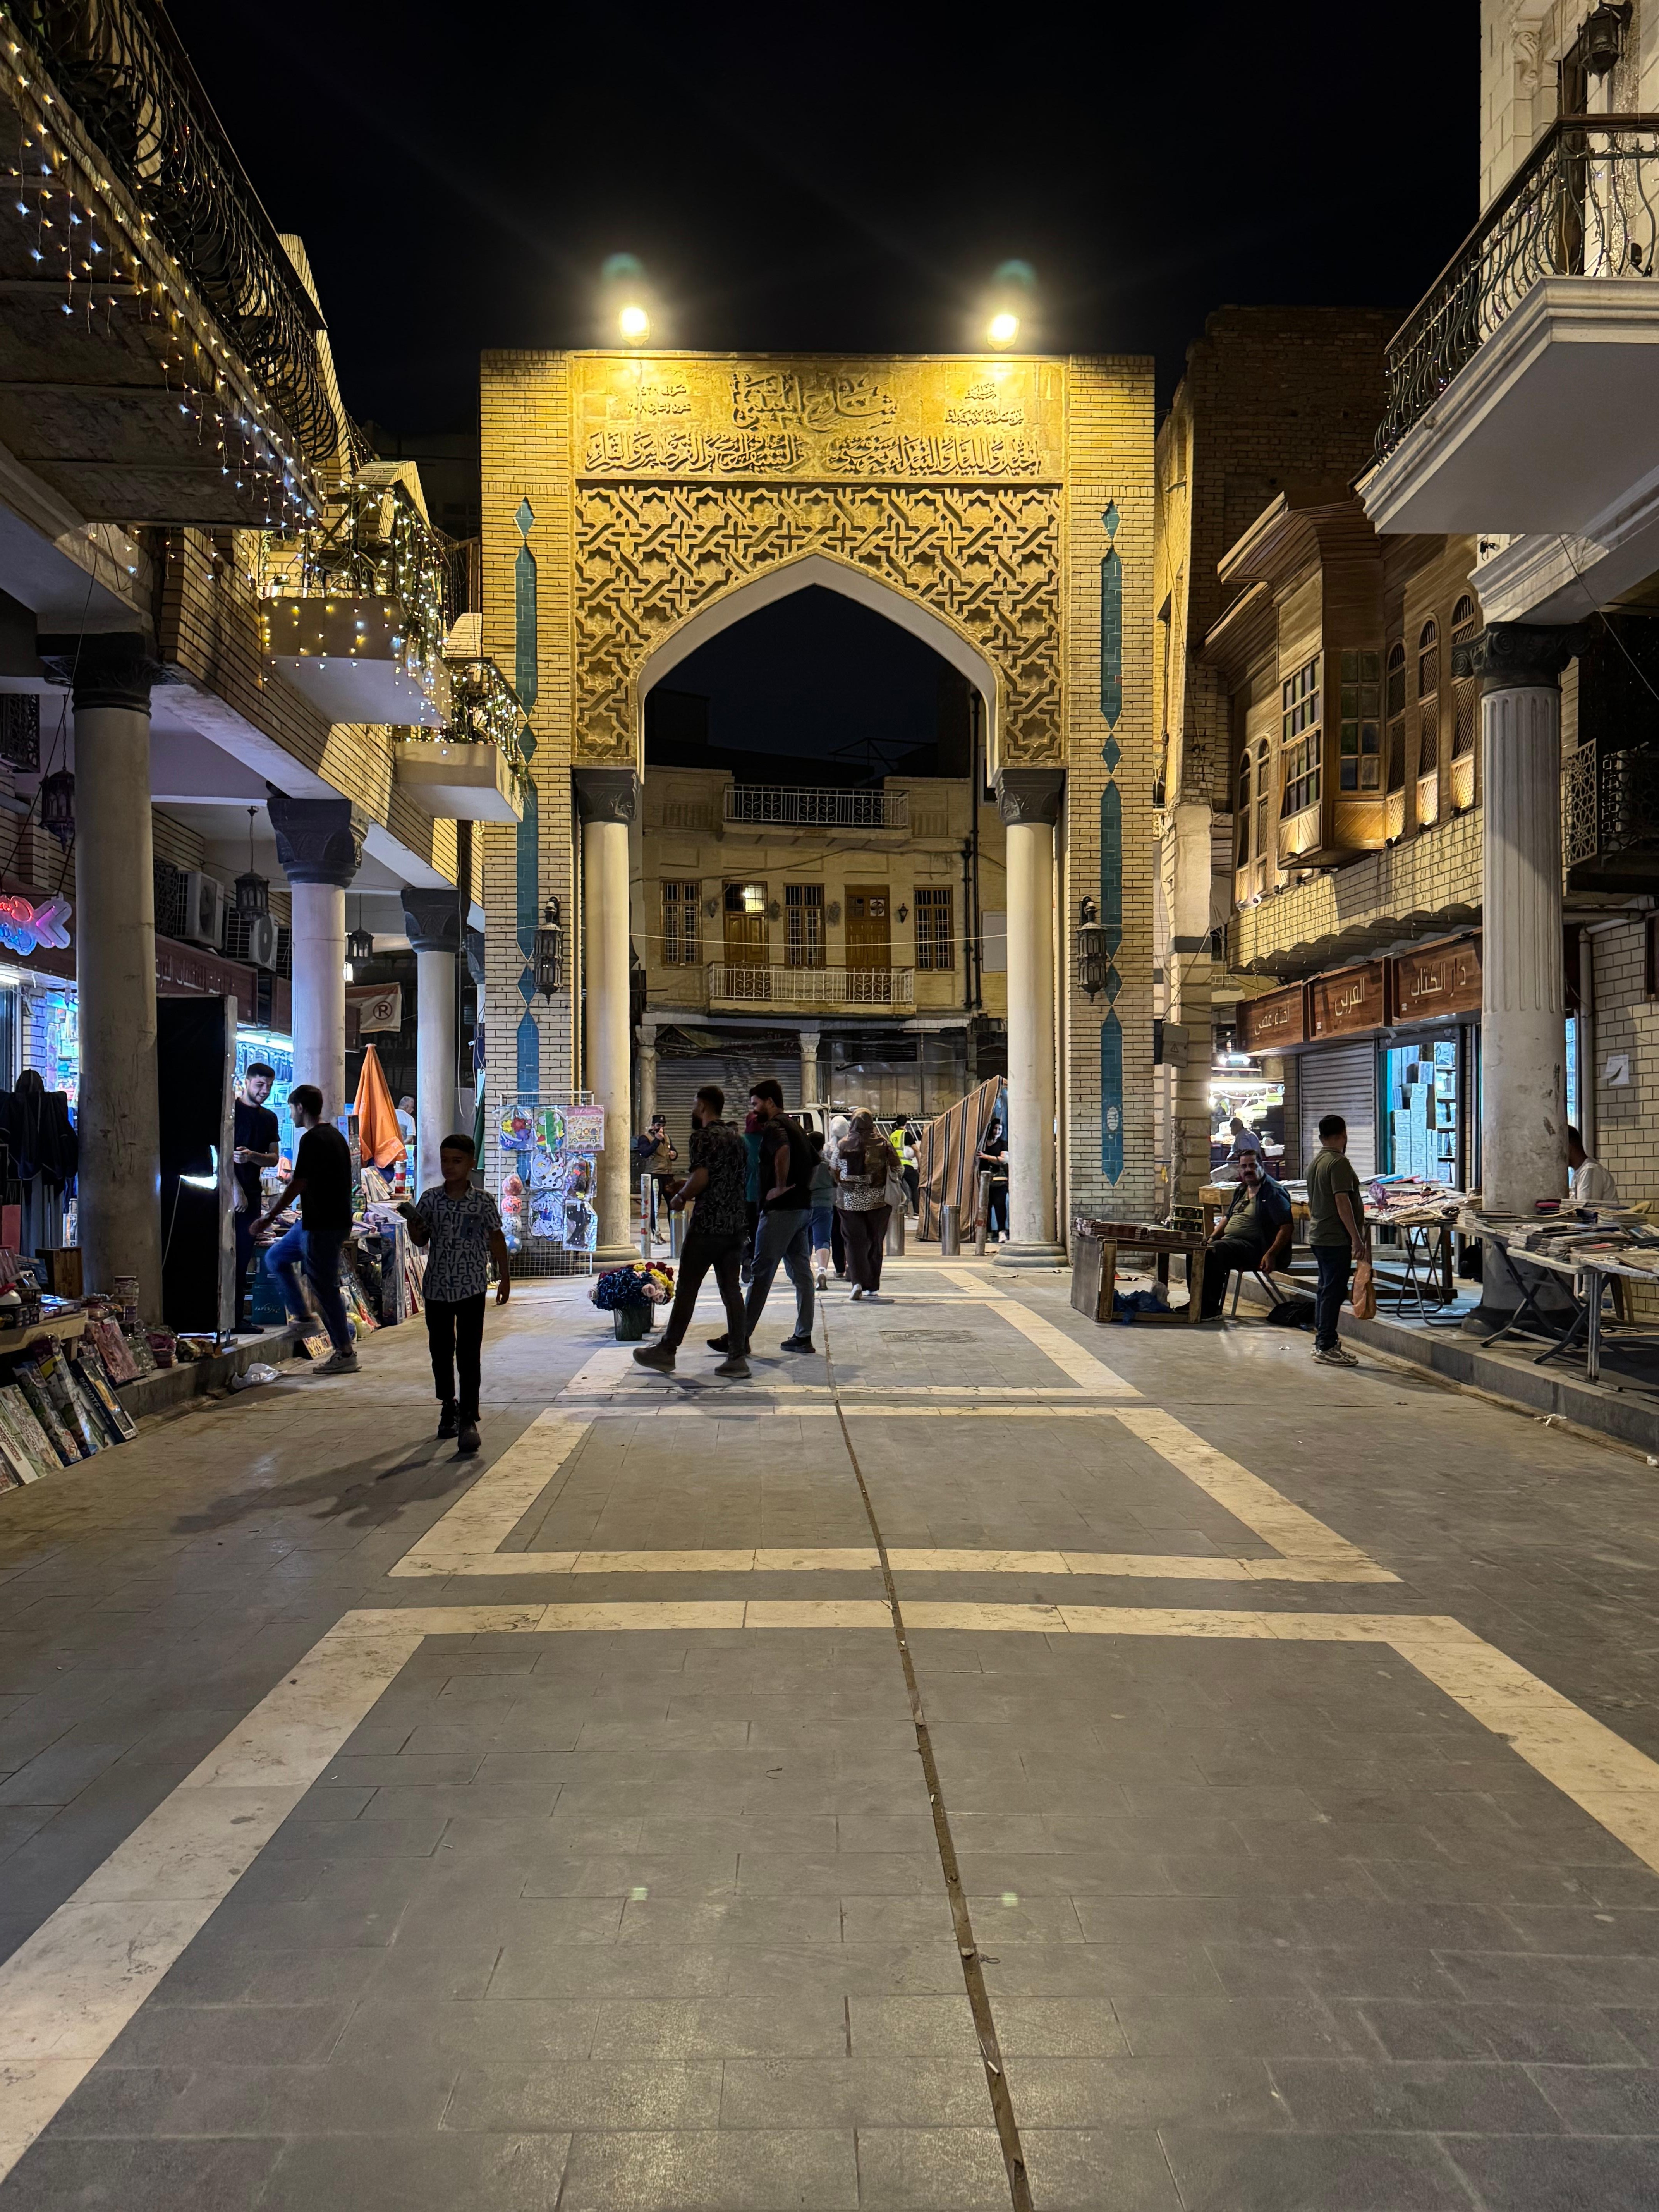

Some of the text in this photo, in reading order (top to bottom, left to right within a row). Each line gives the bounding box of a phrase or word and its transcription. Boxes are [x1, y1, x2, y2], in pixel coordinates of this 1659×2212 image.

[730, 375, 898, 433] شارع المتنبي
[1334, 977, 1365, 1024] العربي
[1410, 958, 1466, 1004] دار الكتاب
